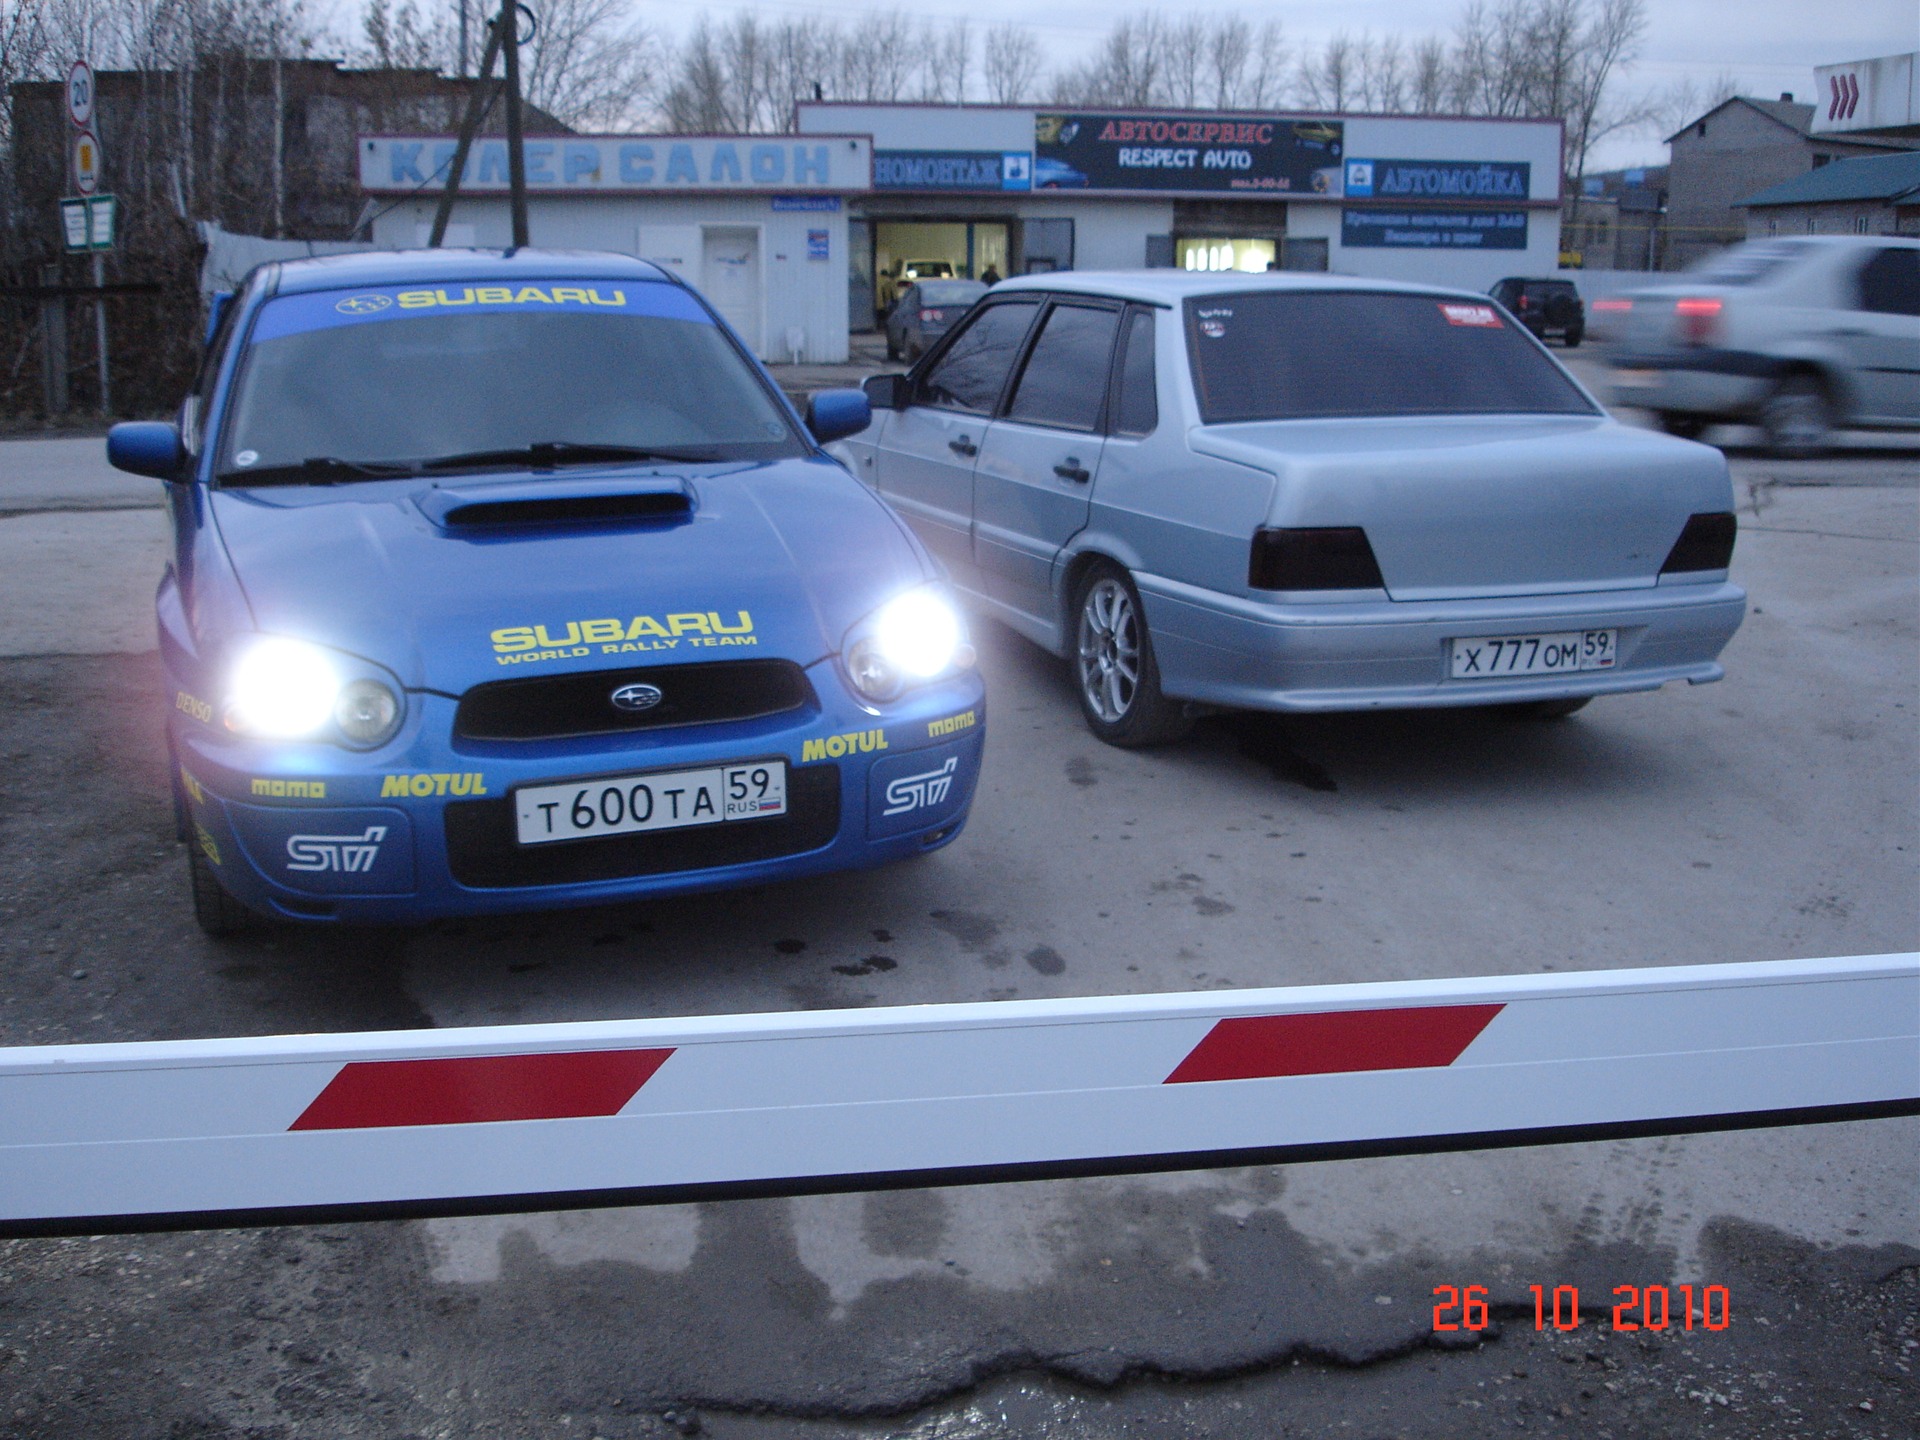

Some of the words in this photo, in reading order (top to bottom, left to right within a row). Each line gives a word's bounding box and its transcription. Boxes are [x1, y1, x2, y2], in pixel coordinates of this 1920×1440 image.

[73, 80, 87, 106] 20
[1099, 121, 1273, 144] АВТОСЕРВИС
[618, 143, 828, 183] САЛОН
[1118, 147, 1198, 168] RESPECT
[1381, 164, 1525, 196] АВТОМОЙКА
[397, 287, 626, 308] SUBARU
[490, 610, 754, 654] SUBARU
[1585, 632, 1609, 657] 59
[496, 646, 590, 666] WORLD
[602, 638, 679, 655] RALLY
[688, 635, 758, 647] TEAM
[176, 692, 211, 723] DENSO
[803, 729, 888, 762] MOTUL
[381, 773, 487, 797] MOTUL
[729, 768, 769, 800] 59
[727, 801, 758, 814] RUS
